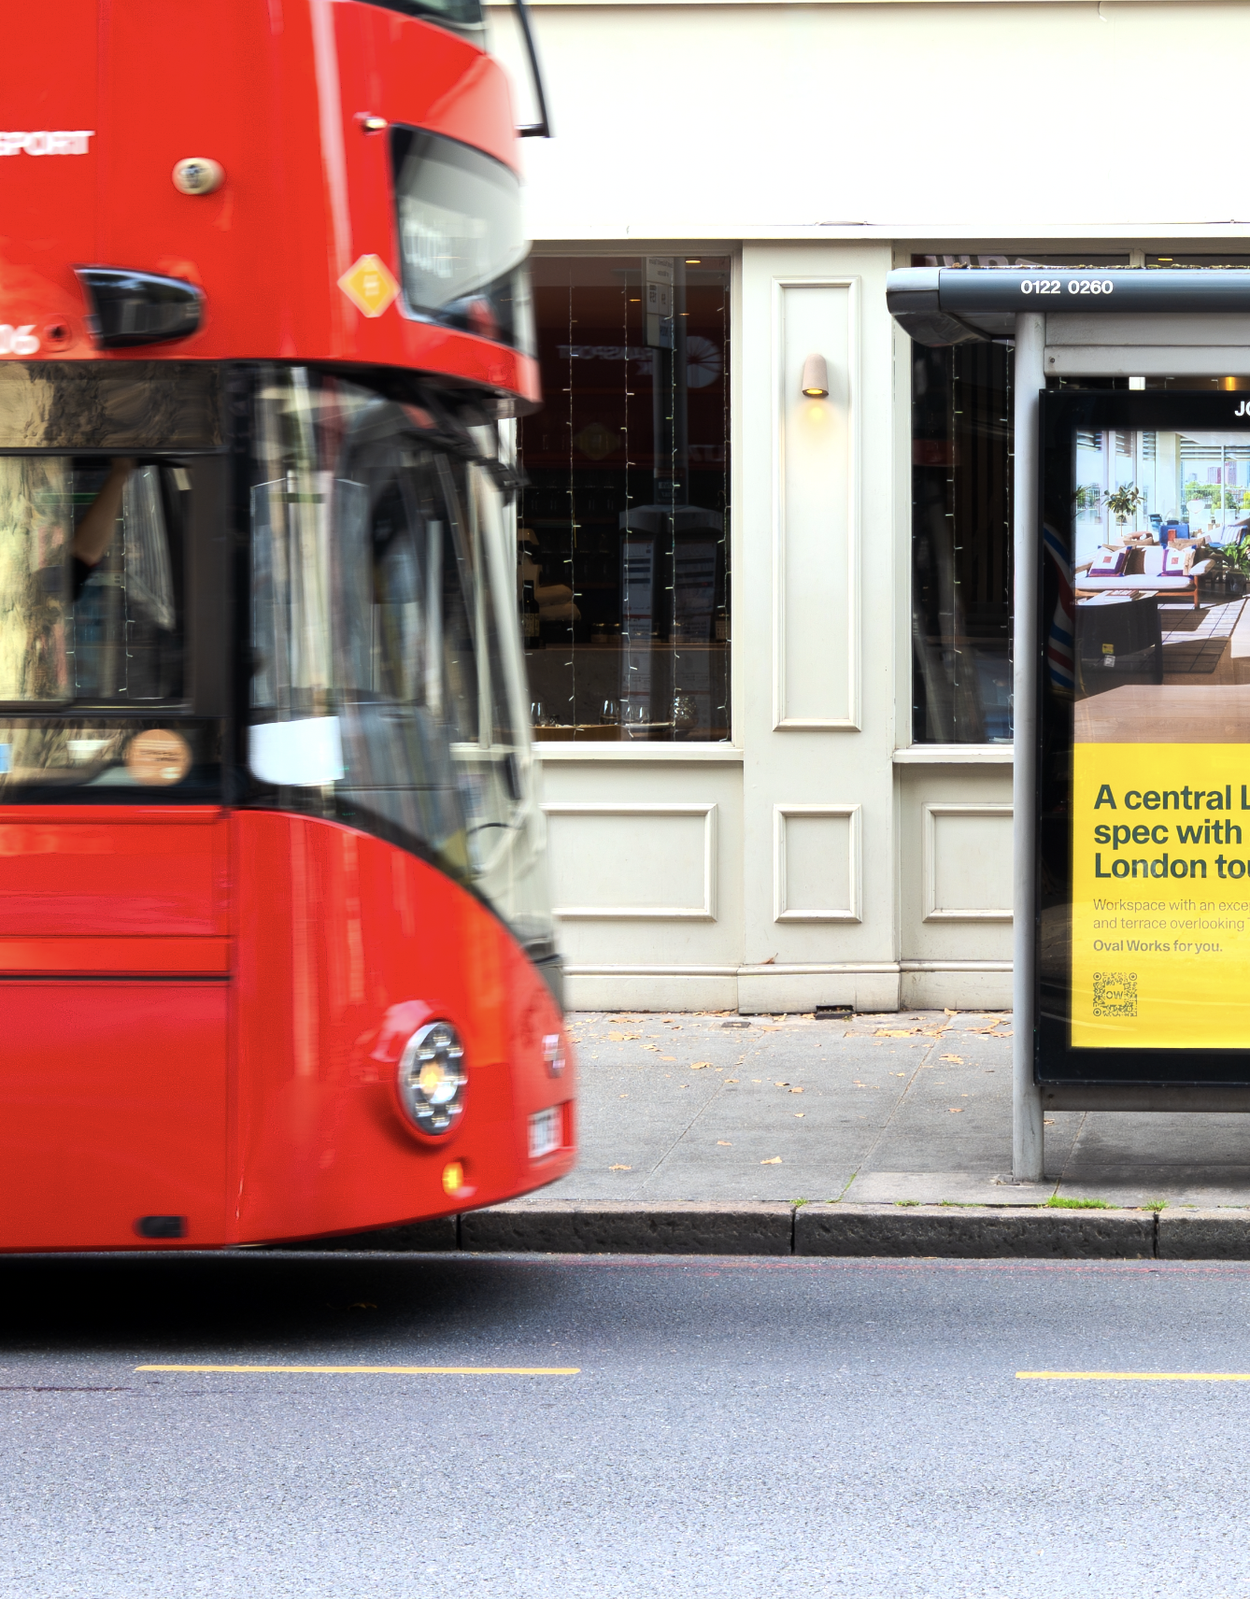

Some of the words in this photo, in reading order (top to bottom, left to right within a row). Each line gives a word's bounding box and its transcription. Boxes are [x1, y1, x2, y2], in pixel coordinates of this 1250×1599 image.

[1020, 280, 1061, 294] 0122
[1067, 280, 1114, 294] 0260
[1094, 784, 1117, 809] A
[1124, 785, 1231, 810] central
[1094, 825, 1169, 850] spec
[1176, 819, 1242, 844] with
[1095, 853, 1207, 879] London
[1093, 899, 1166, 913] Workspace
[1169, 899, 1196, 911] with
[1200, 902, 1215, 911] an
[1093, 917, 1117, 929] and
[1121, 918, 1167, 929] terrace
[1170, 918, 1244, 932] overlooking
[1093, 940, 1123, 952] Oval
[1127, 940, 1170, 952] Works
[1173, 940, 1193, 952] for
[1195, 943, 1222, 955] you.
[1106, 990, 1123, 1000] OW
